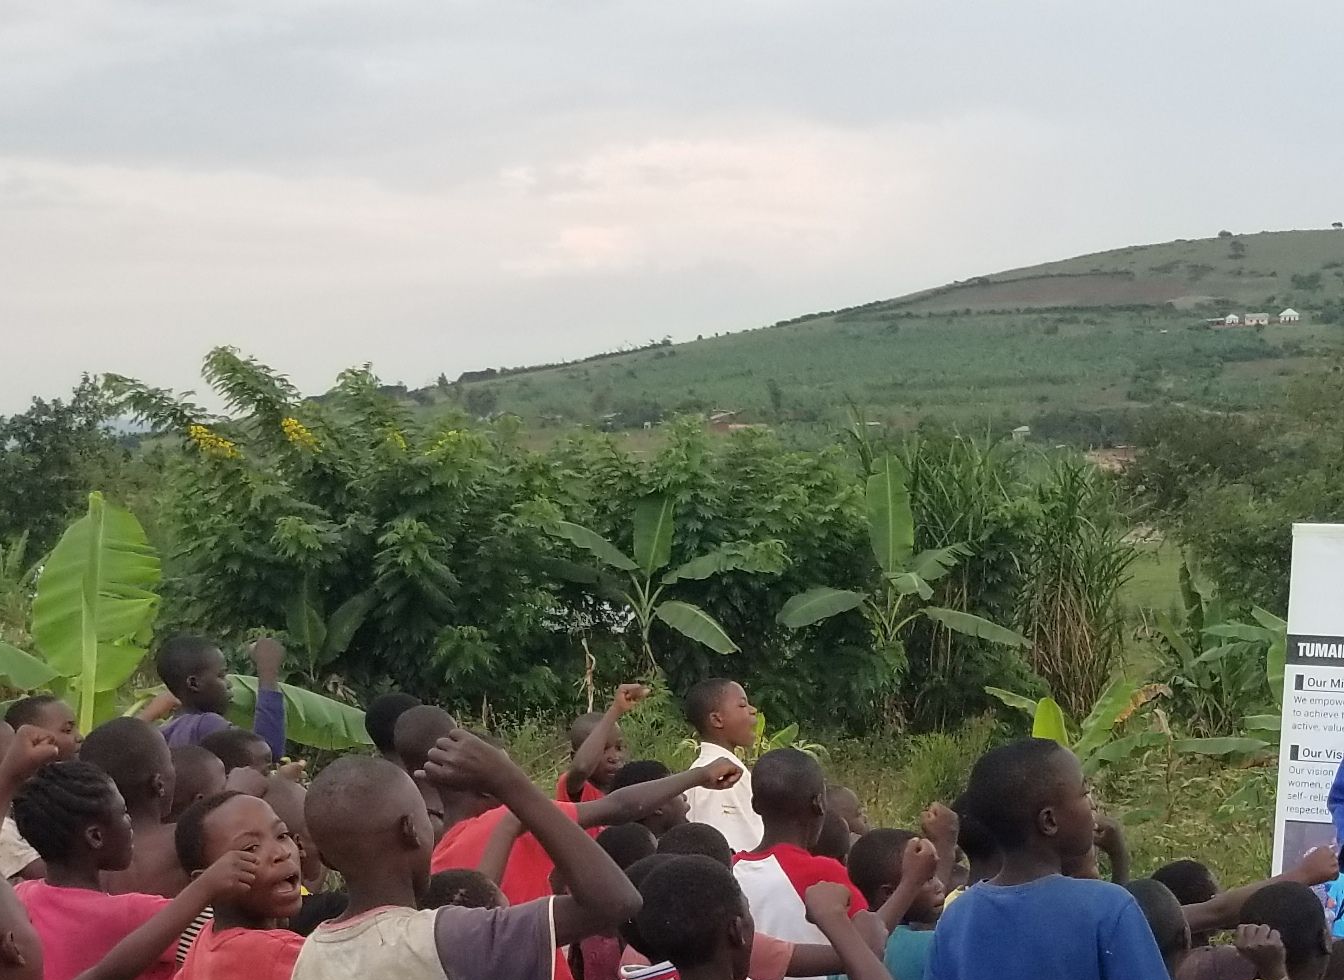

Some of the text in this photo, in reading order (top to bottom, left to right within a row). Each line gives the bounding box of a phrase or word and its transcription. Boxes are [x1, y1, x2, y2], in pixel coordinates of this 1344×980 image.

[1307, 677, 1327, 688] Our
[1293, 696, 1307, 704] We
[1303, 710, 1340, 719] achieve
[1302, 748, 1322, 759] Our
[1288, 766, 1334, 776] Our vision
[1288, 780, 1323, 789] women,
